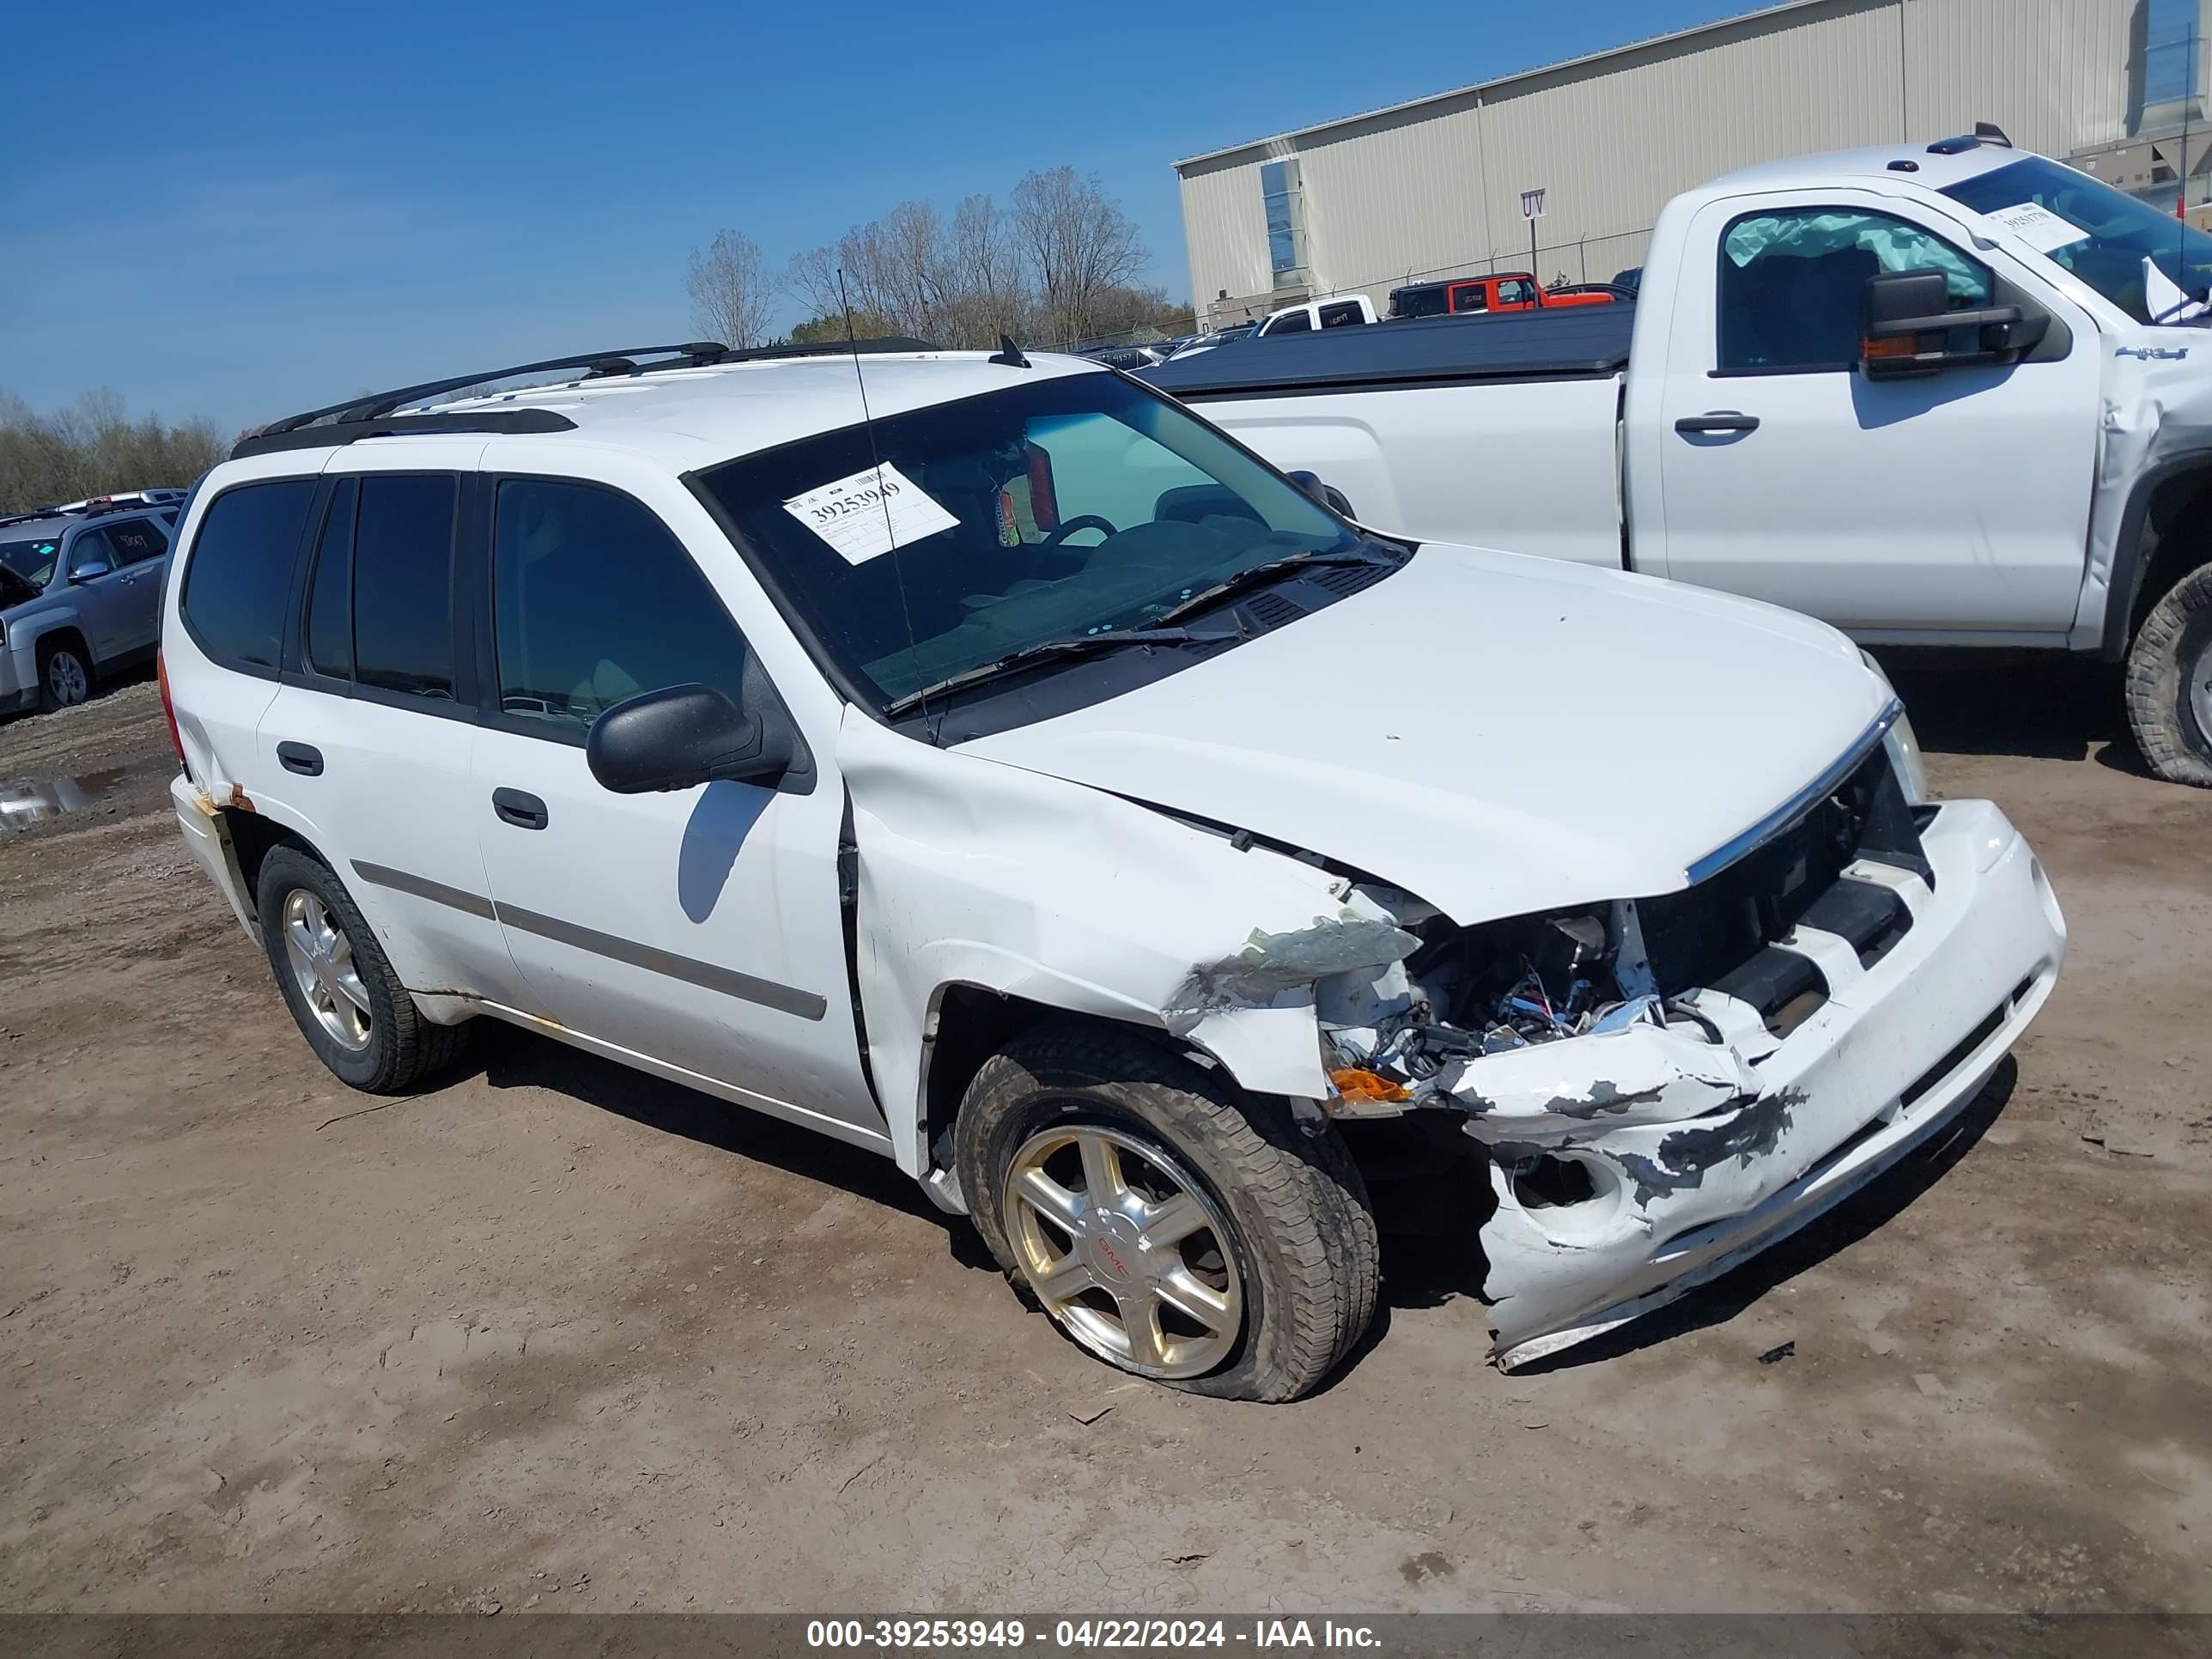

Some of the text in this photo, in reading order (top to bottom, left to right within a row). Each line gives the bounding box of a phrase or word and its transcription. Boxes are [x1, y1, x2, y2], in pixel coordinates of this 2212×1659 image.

[1522, 192, 1543, 217] UV
[2002, 211, 2049, 228] 39251770
[810, 483, 900, 523] 39253949
[1098, 1237, 1130, 1279] GMC
